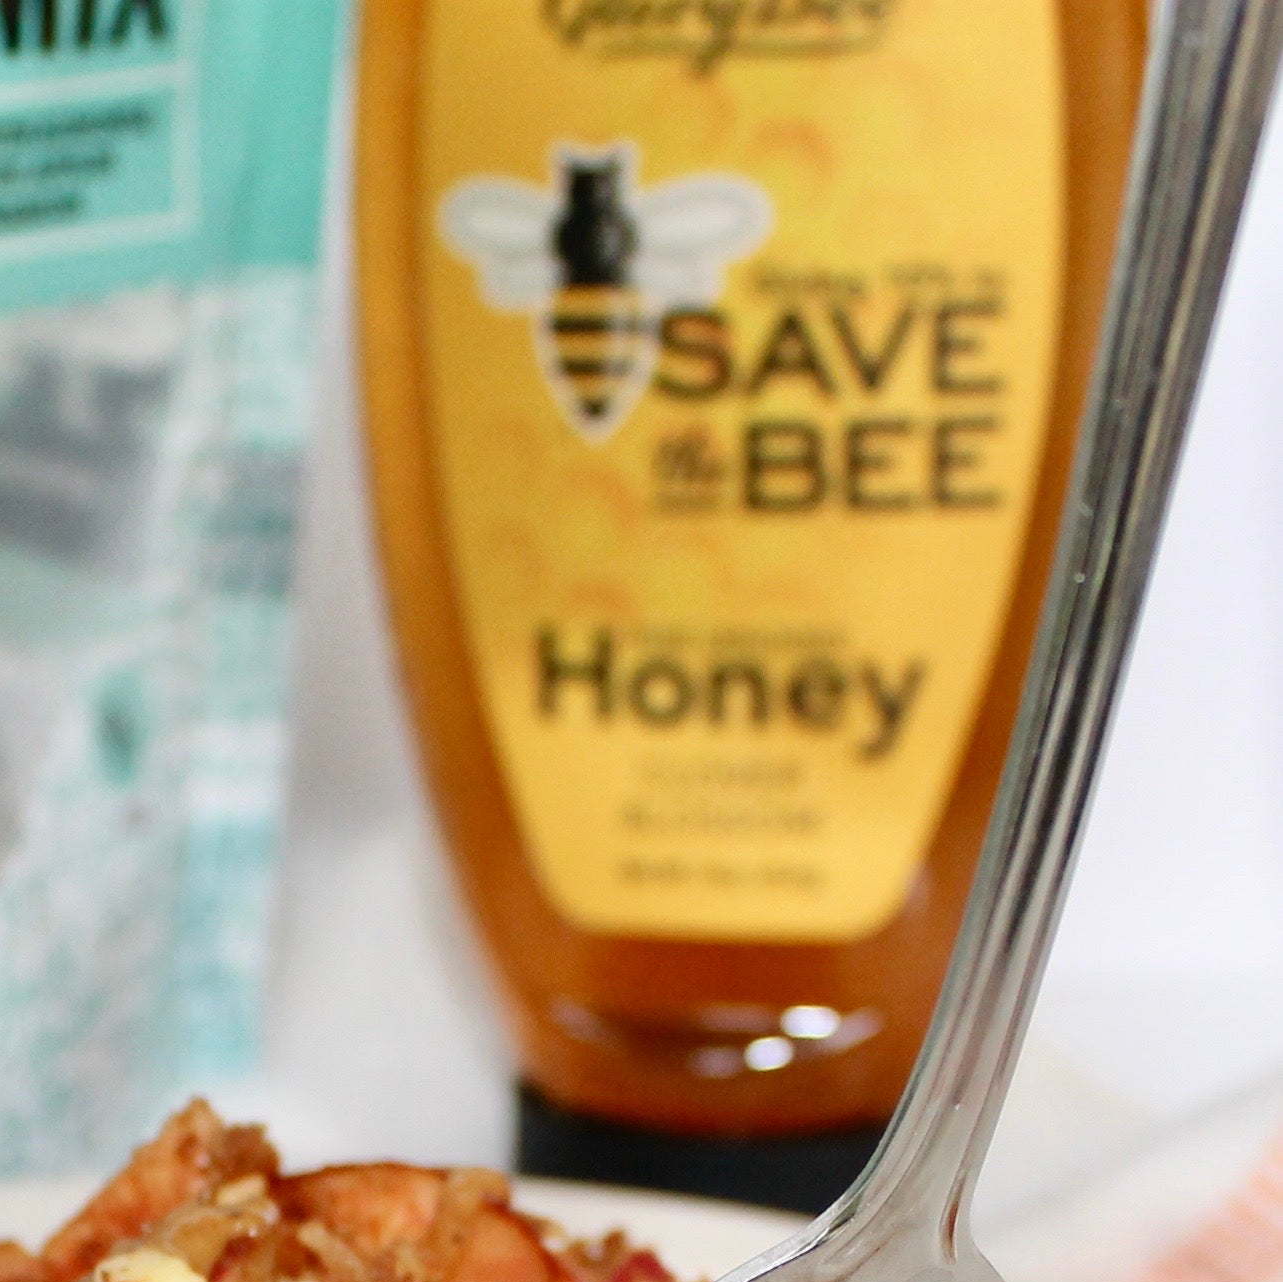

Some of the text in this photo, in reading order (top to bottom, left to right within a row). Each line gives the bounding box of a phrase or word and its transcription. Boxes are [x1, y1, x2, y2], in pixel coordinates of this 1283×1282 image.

[655, 298, 1006, 403] SAVE
[742, 417, 1005, 515] BEE
[534, 620, 928, 764] Honey
